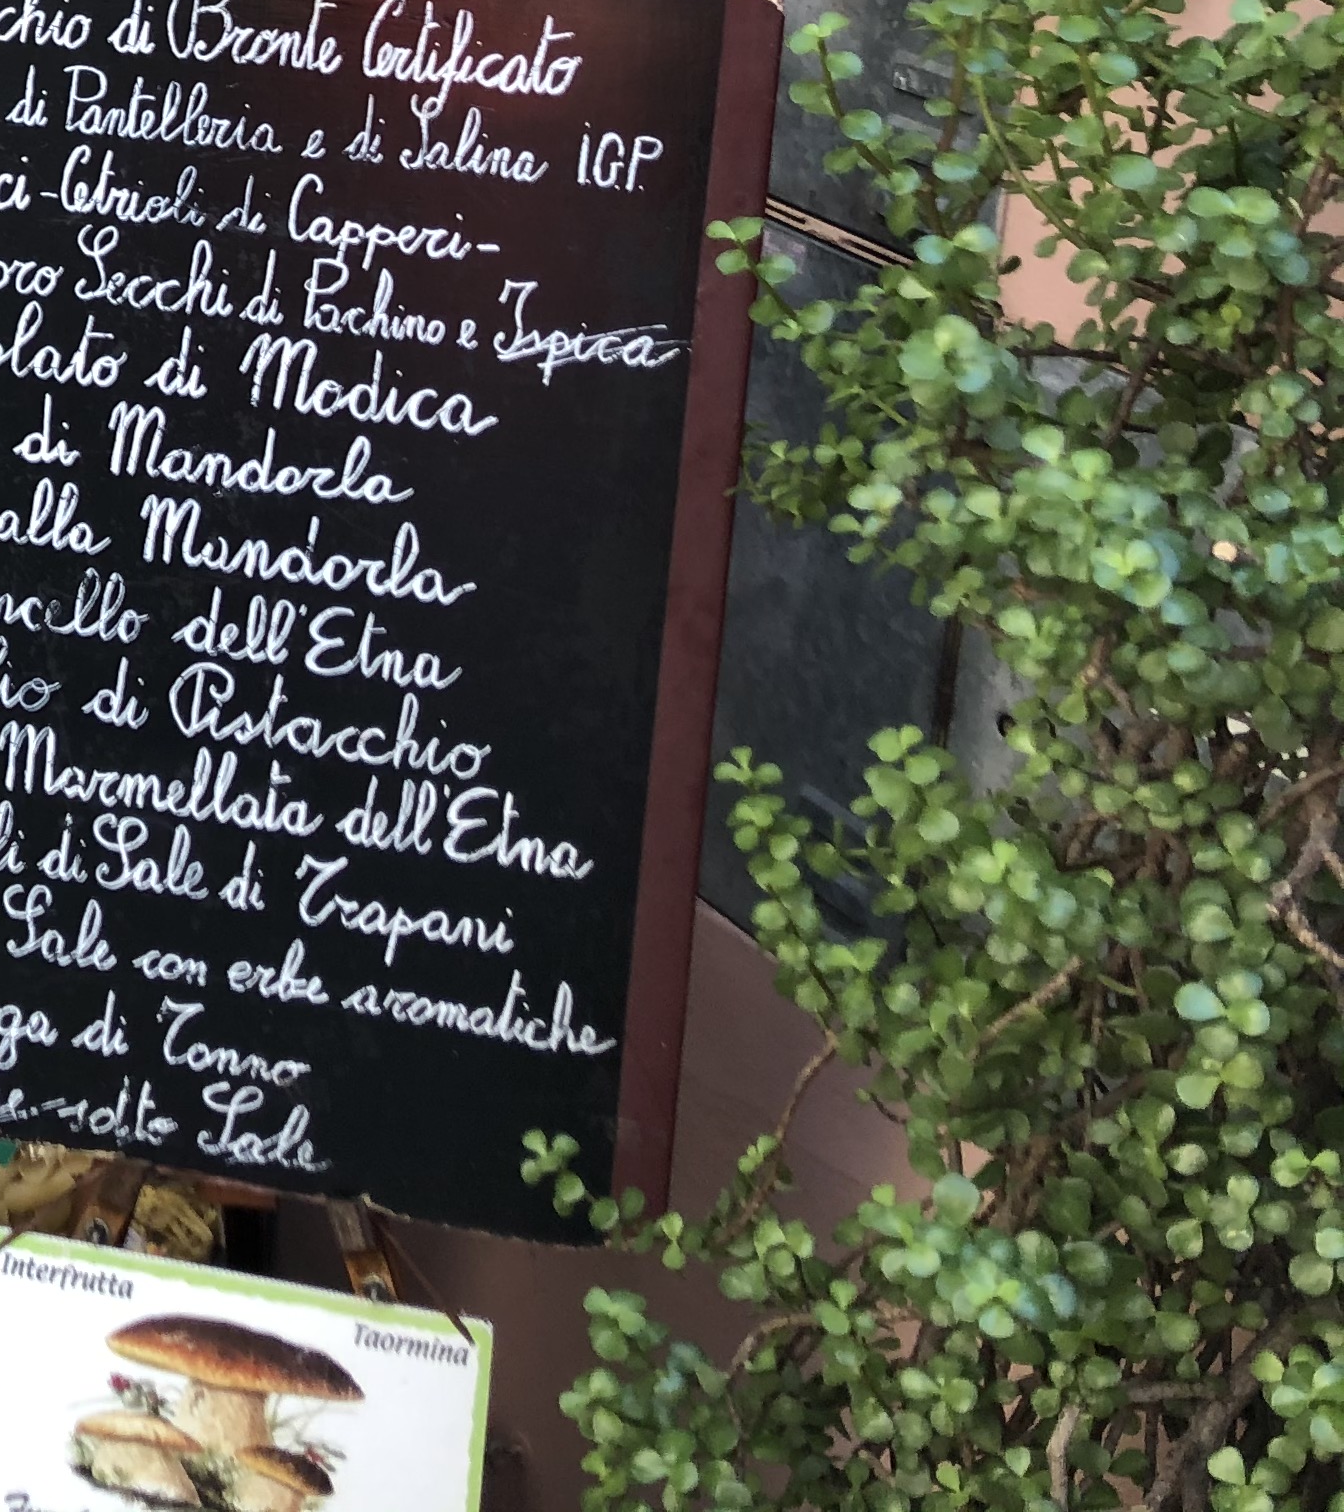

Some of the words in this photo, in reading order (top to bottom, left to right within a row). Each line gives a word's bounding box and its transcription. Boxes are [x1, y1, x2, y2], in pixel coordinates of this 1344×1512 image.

[6, 65, 48, 128] di
[64, 65, 283, 159] Pantelleria
[301, 128, 326, 159] e
[343, 93, 384, 164] di
[400, 93, 549, 183] Salina
[215, 175, 267, 234] di
[75, 223, 234, 319] Secchi
[241, 249, 284, 327] di
[303, 256, 446, 346] Pachino
[456, 319, 479, 350] e
[144, 325, 208, 399] di
[239, 332, 499, 436] Modica
[13, 393, 82, 467] di
[108, 400, 414, 504] Mandorla
[140, 494, 478, 605] Mandorla
[82, 656, 150, 730] di
[168, 661, 492, 780] Pistacchio
[37, 812, 88, 884] di
[92, 812, 212, 900] Sale
[218, 838, 266, 912] di
[294, 854, 516, 967] Trapani
[1, 884, 118, 974] Sale
[133, 948, 209, 988] con
[226, 938, 330, 1006] erbe
[341, 969, 618, 1055] aromatiche
[71, 989, 130, 1058] di
[156, 996, 312, 1085] Tonno
[197, 1080, 331, 1172] Sale
[0, 1250, 135, 1301] Interfrutta
[352, 1320, 471, 1367] Taormina
